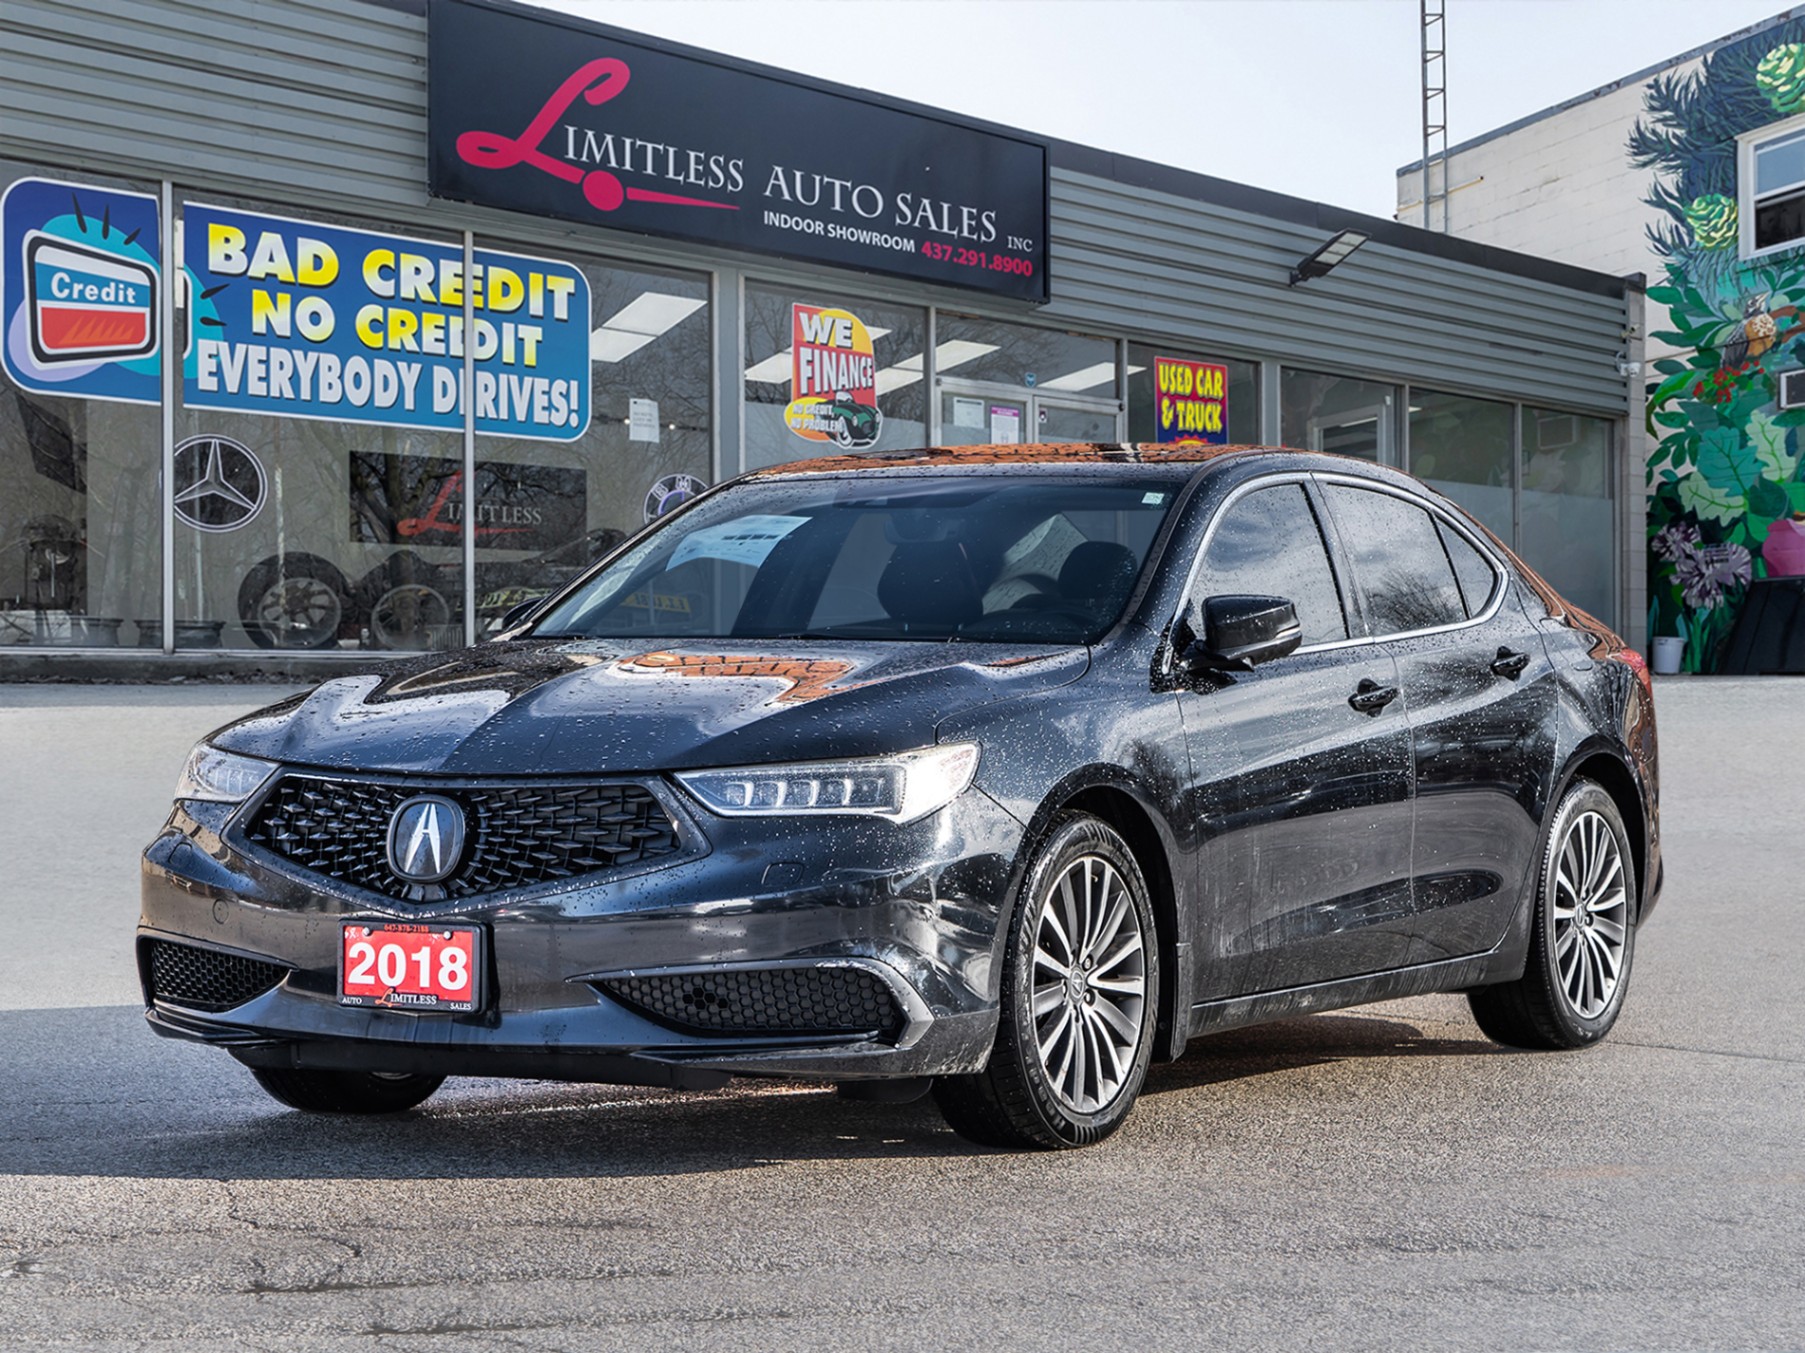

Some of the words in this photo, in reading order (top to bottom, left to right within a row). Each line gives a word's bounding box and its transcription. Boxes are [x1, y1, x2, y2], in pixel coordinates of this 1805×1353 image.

[456, 57, 744, 194] LIMITLESS
[763, 165, 884, 219] AUTO
[895, 192, 997, 243] SALES
[1007, 235, 1033, 252] INC
[763, 210, 825, 236] INDOOR
[827, 223, 916, 253] SHOWROOM
[921, 241, 1033, 277] 437.291.8900
[51, 271, 136, 304] Credit
[208, 222, 340, 287] BAD
[362, 248, 575, 322] CREDIT
[252, 288, 336, 342] NO
[355, 303, 543, 368] CREDIT
[799, 312, 853, 349] WE
[197, 338, 422, 411] EVERYBODY
[433, 364, 579, 428] DRIVES!
[799, 346, 873, 396] FINANCE
[1158, 361, 1193, 397] USED
[1195, 366, 1224, 401] CAR
[1161, 395, 1175, 430] &
[1176, 399, 1223, 434] TRUCK
[347, 942, 468, 991] 2018
[342, 997, 363, 1005] AUTO
[375, 988, 438, 1008] LIMITLESS
[450, 1002, 472, 1010] SALES
